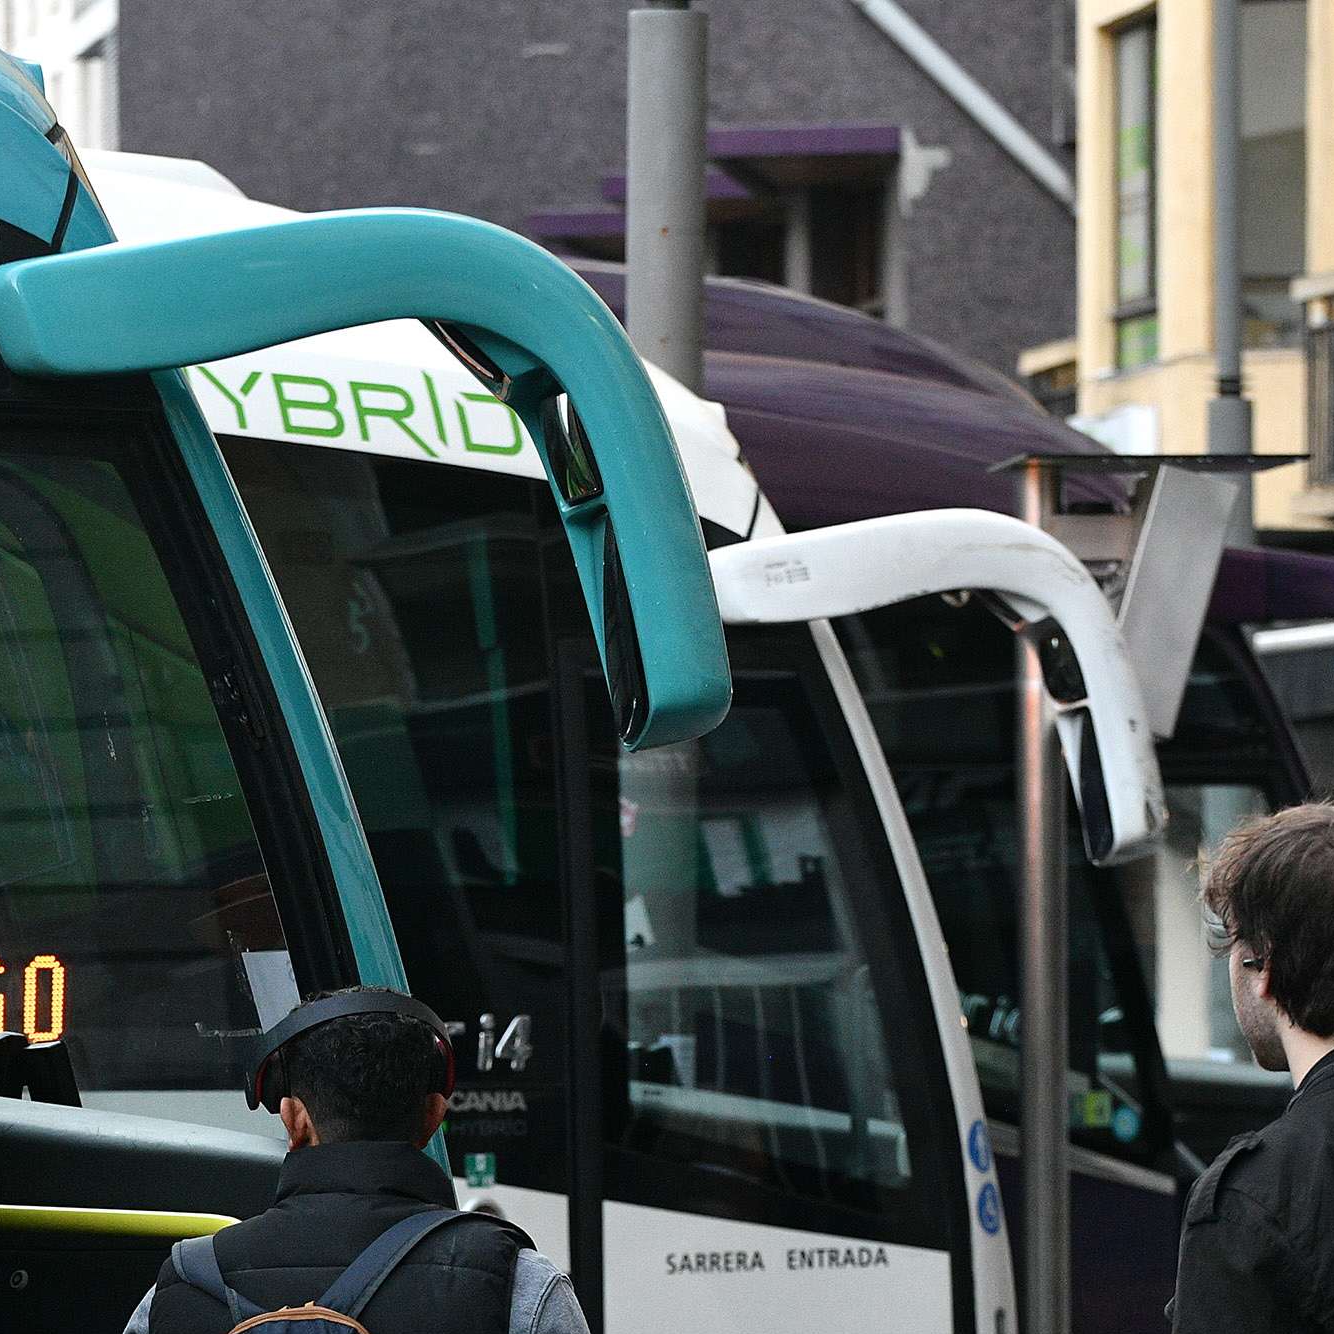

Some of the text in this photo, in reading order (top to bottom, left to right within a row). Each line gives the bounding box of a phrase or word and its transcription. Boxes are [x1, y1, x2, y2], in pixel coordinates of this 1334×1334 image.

[181, 365, 524, 458] YBRID
[476, 1012, 534, 1072] i4
[450, 1090, 528, 1112] CANIA
[665, 1246, 890, 1275] SARRERA ENTRADA
